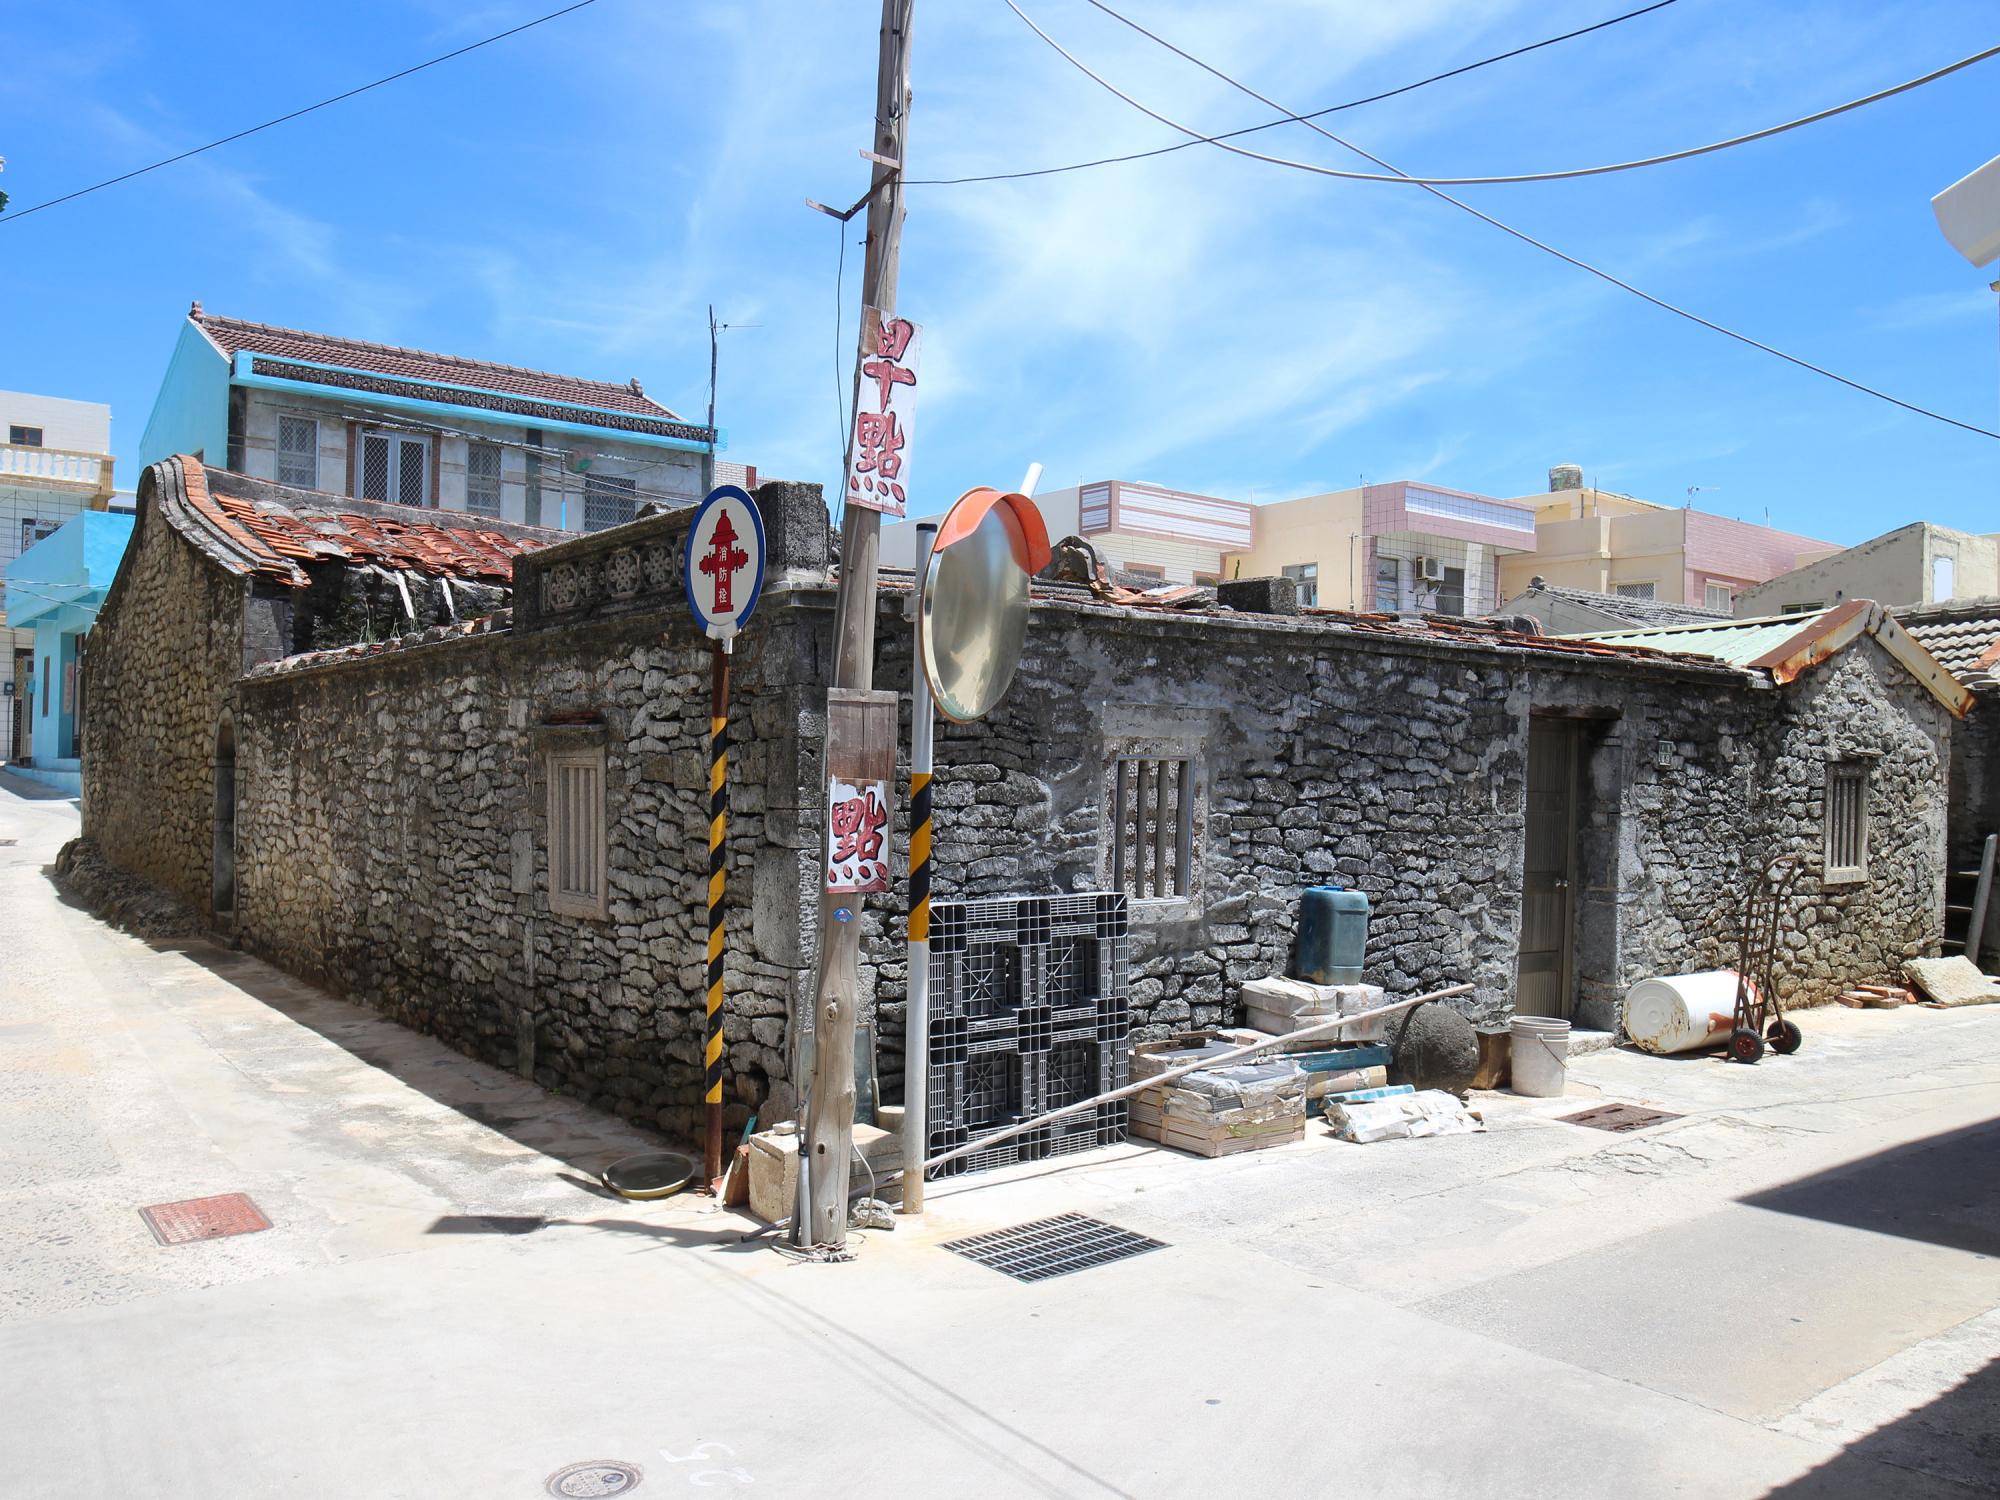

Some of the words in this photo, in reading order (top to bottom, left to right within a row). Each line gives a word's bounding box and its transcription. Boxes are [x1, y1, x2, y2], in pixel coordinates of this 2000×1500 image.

[850, 318, 917, 503] 早點
[718, 546, 728, 604] 消防栓
[828, 791, 888, 884] 點
